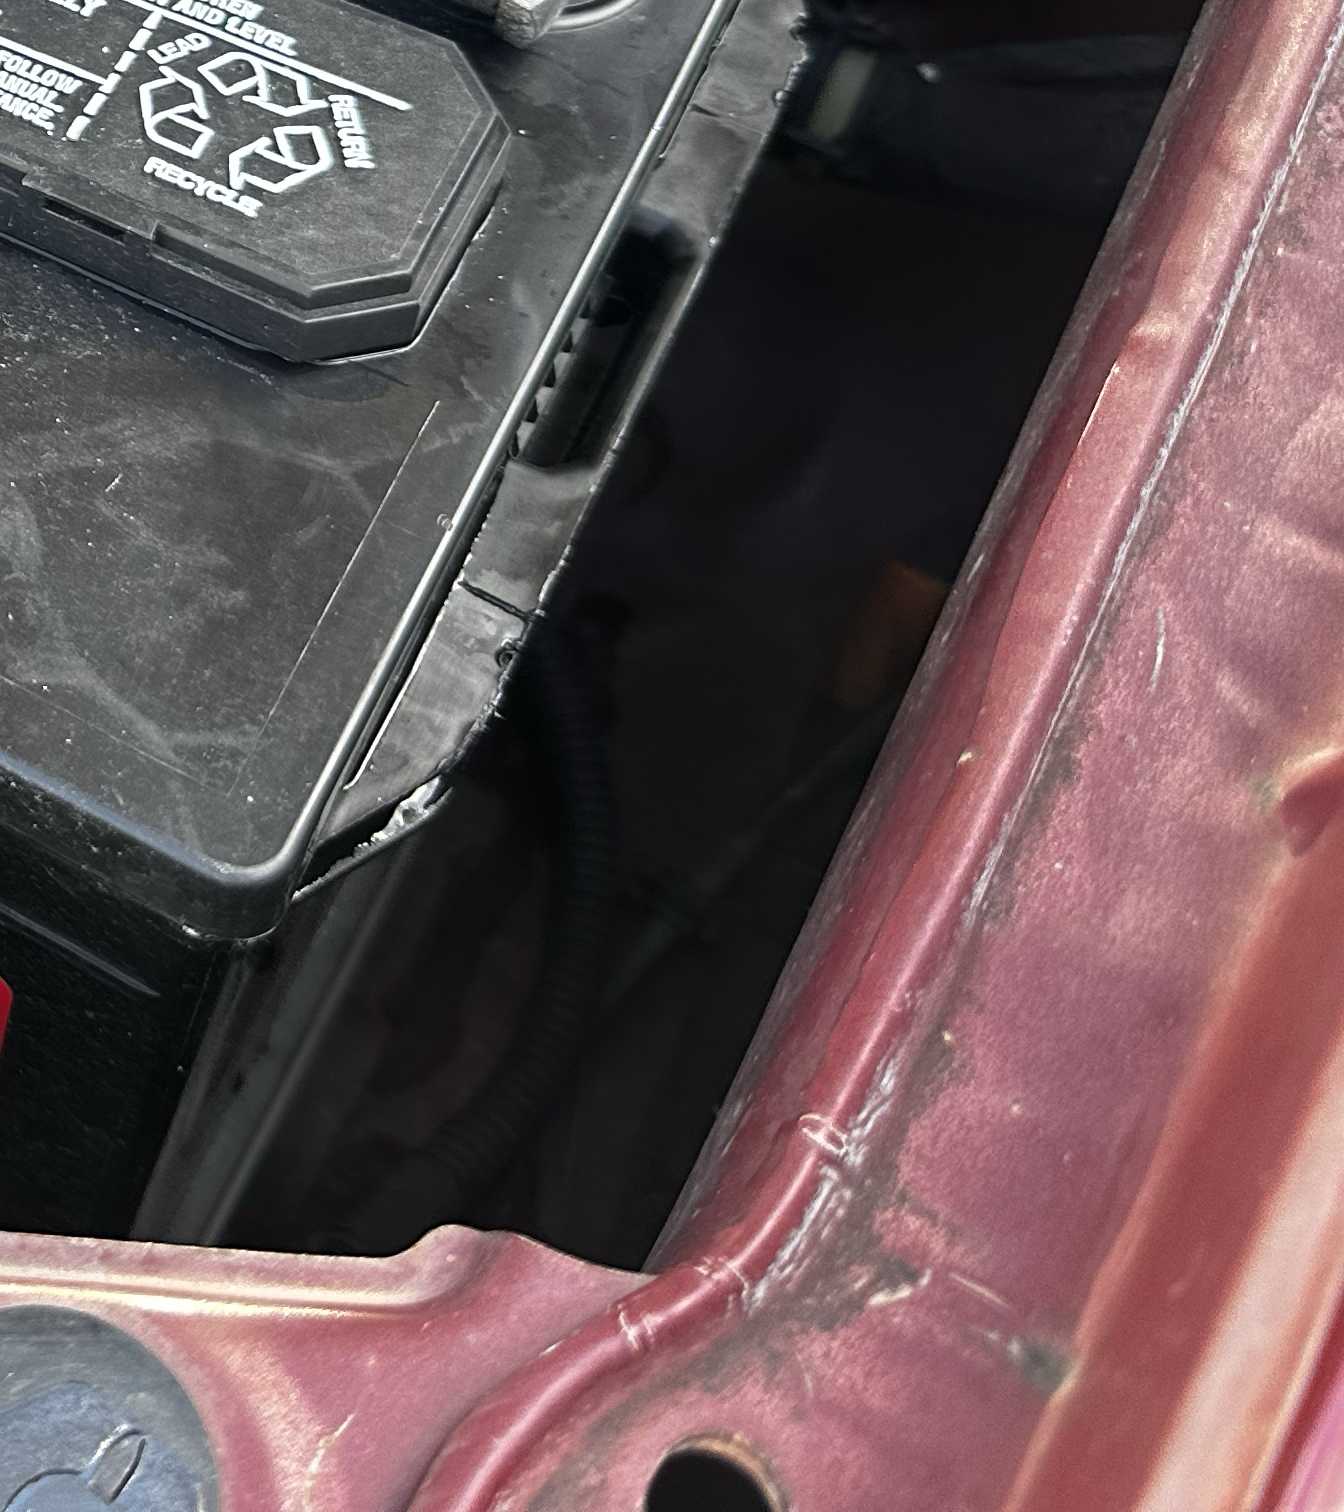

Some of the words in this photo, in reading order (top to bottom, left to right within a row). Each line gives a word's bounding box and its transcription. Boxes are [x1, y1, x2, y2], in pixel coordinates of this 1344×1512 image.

[147, 32, 212, 65] LEAD
[172, 0, 227, 28] AND
[224, 16, 298, 57] LEVEL
[328, 94, 376, 169] RETURN
[143, 156, 263, 218] RECYCLE
